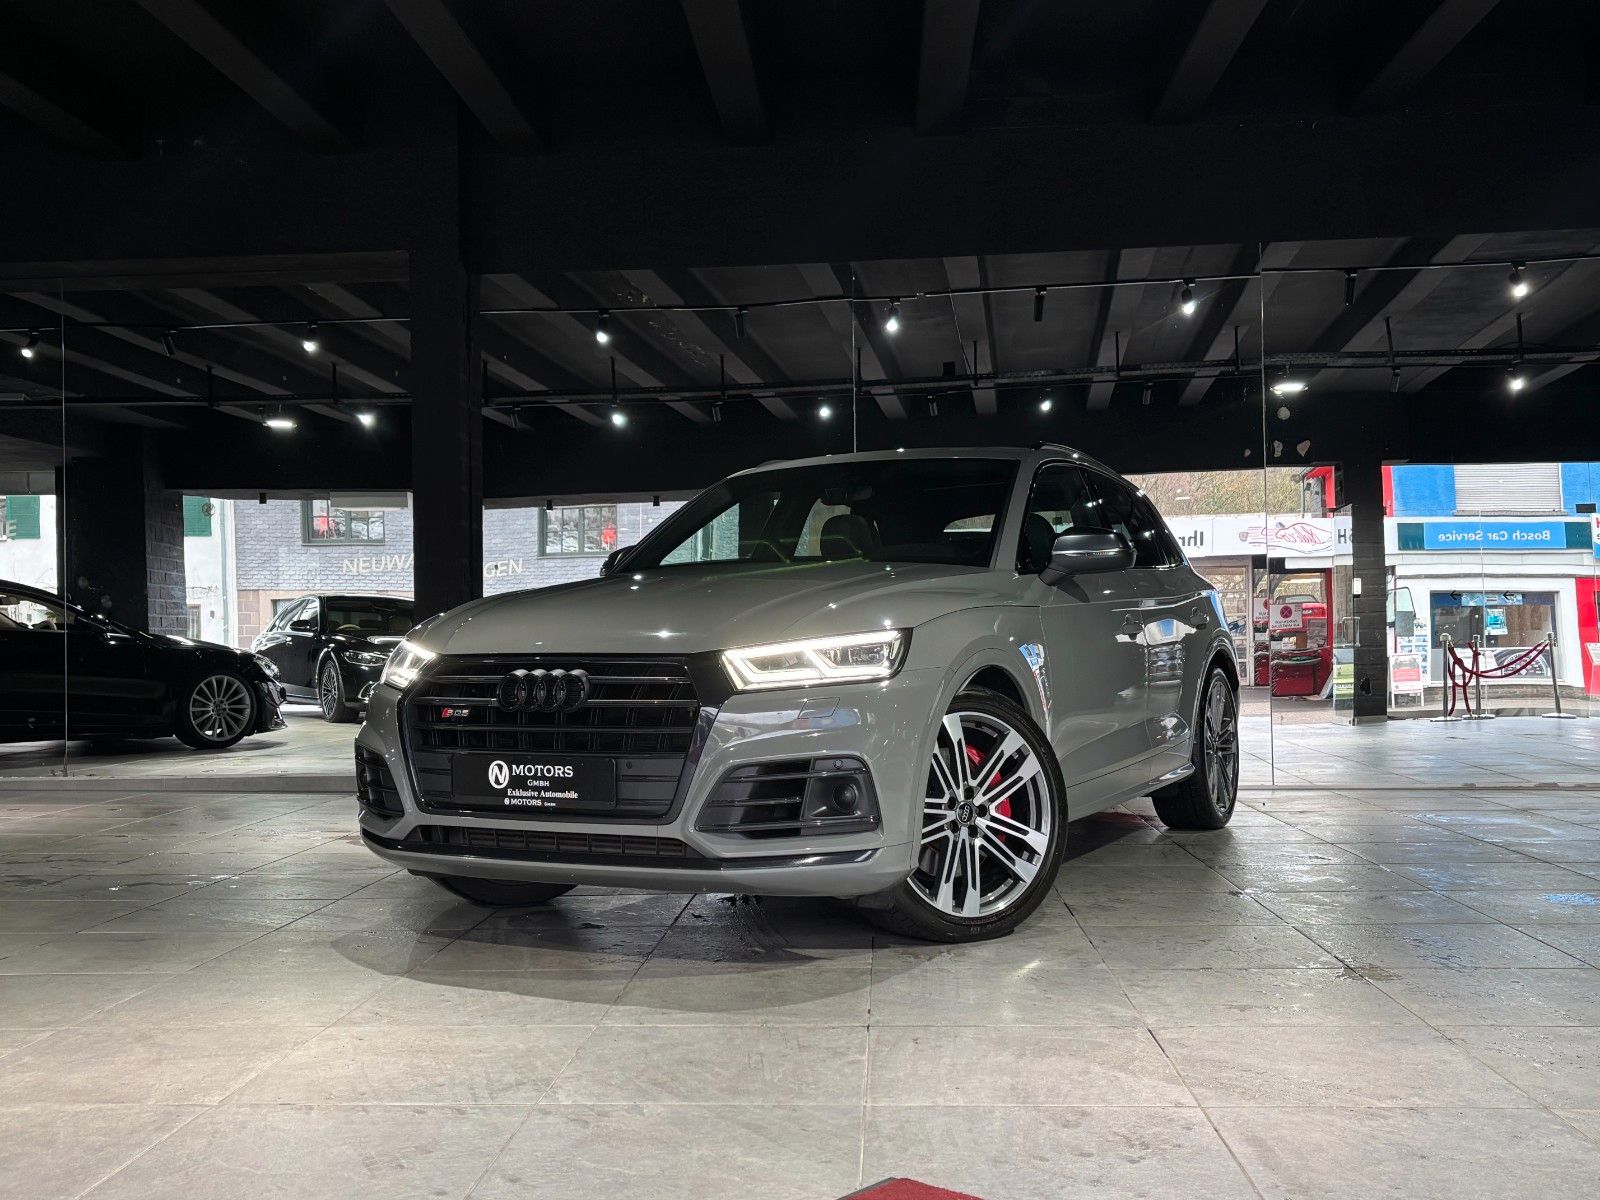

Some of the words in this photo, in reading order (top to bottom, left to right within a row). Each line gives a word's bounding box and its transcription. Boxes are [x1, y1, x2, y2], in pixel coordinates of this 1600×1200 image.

[511, 764, 574, 778] MOTORS
[507, 788, 539, 798] Exklusive
[540, 789, 579, 799] Automobile
[510, 798, 542, 806] MOTORS
